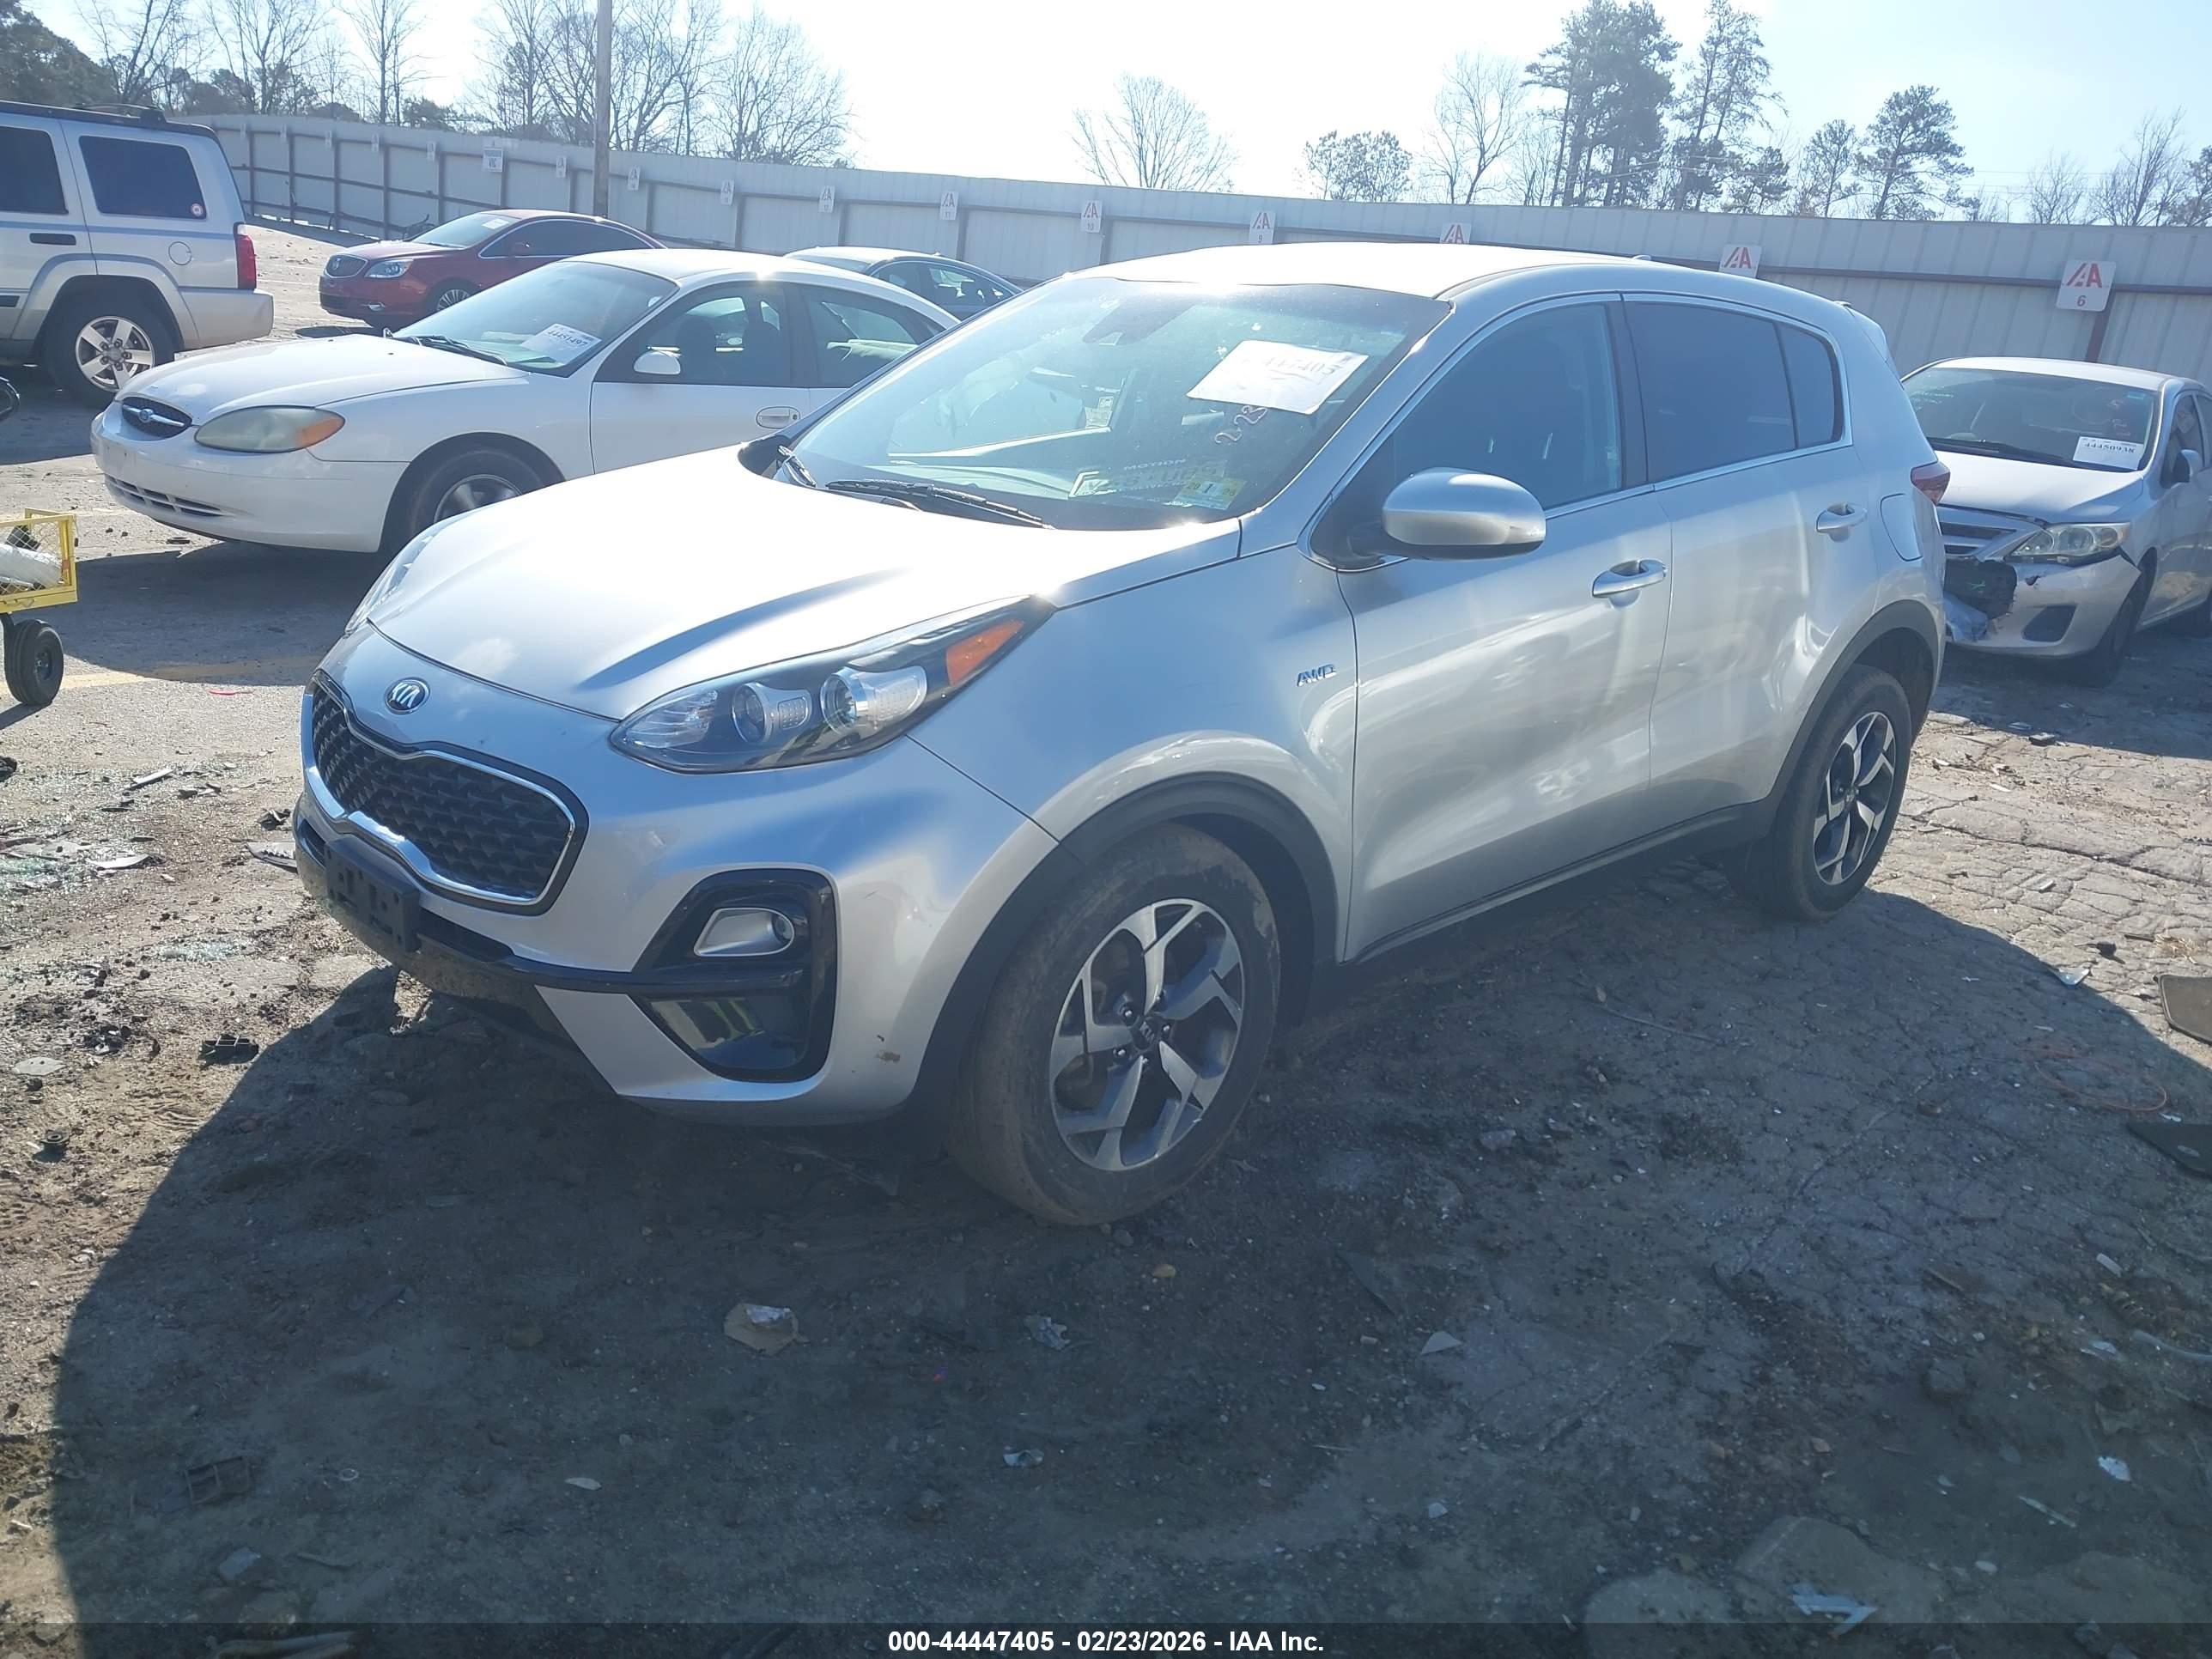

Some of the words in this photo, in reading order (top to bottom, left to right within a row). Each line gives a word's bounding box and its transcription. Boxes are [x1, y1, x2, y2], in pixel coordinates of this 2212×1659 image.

[2076, 295, 2087, 307] 6
[1123, 459, 1187, 471] MOTION
[1296, 663, 1337, 687] AWD
[389, 682, 421, 708] KIA
